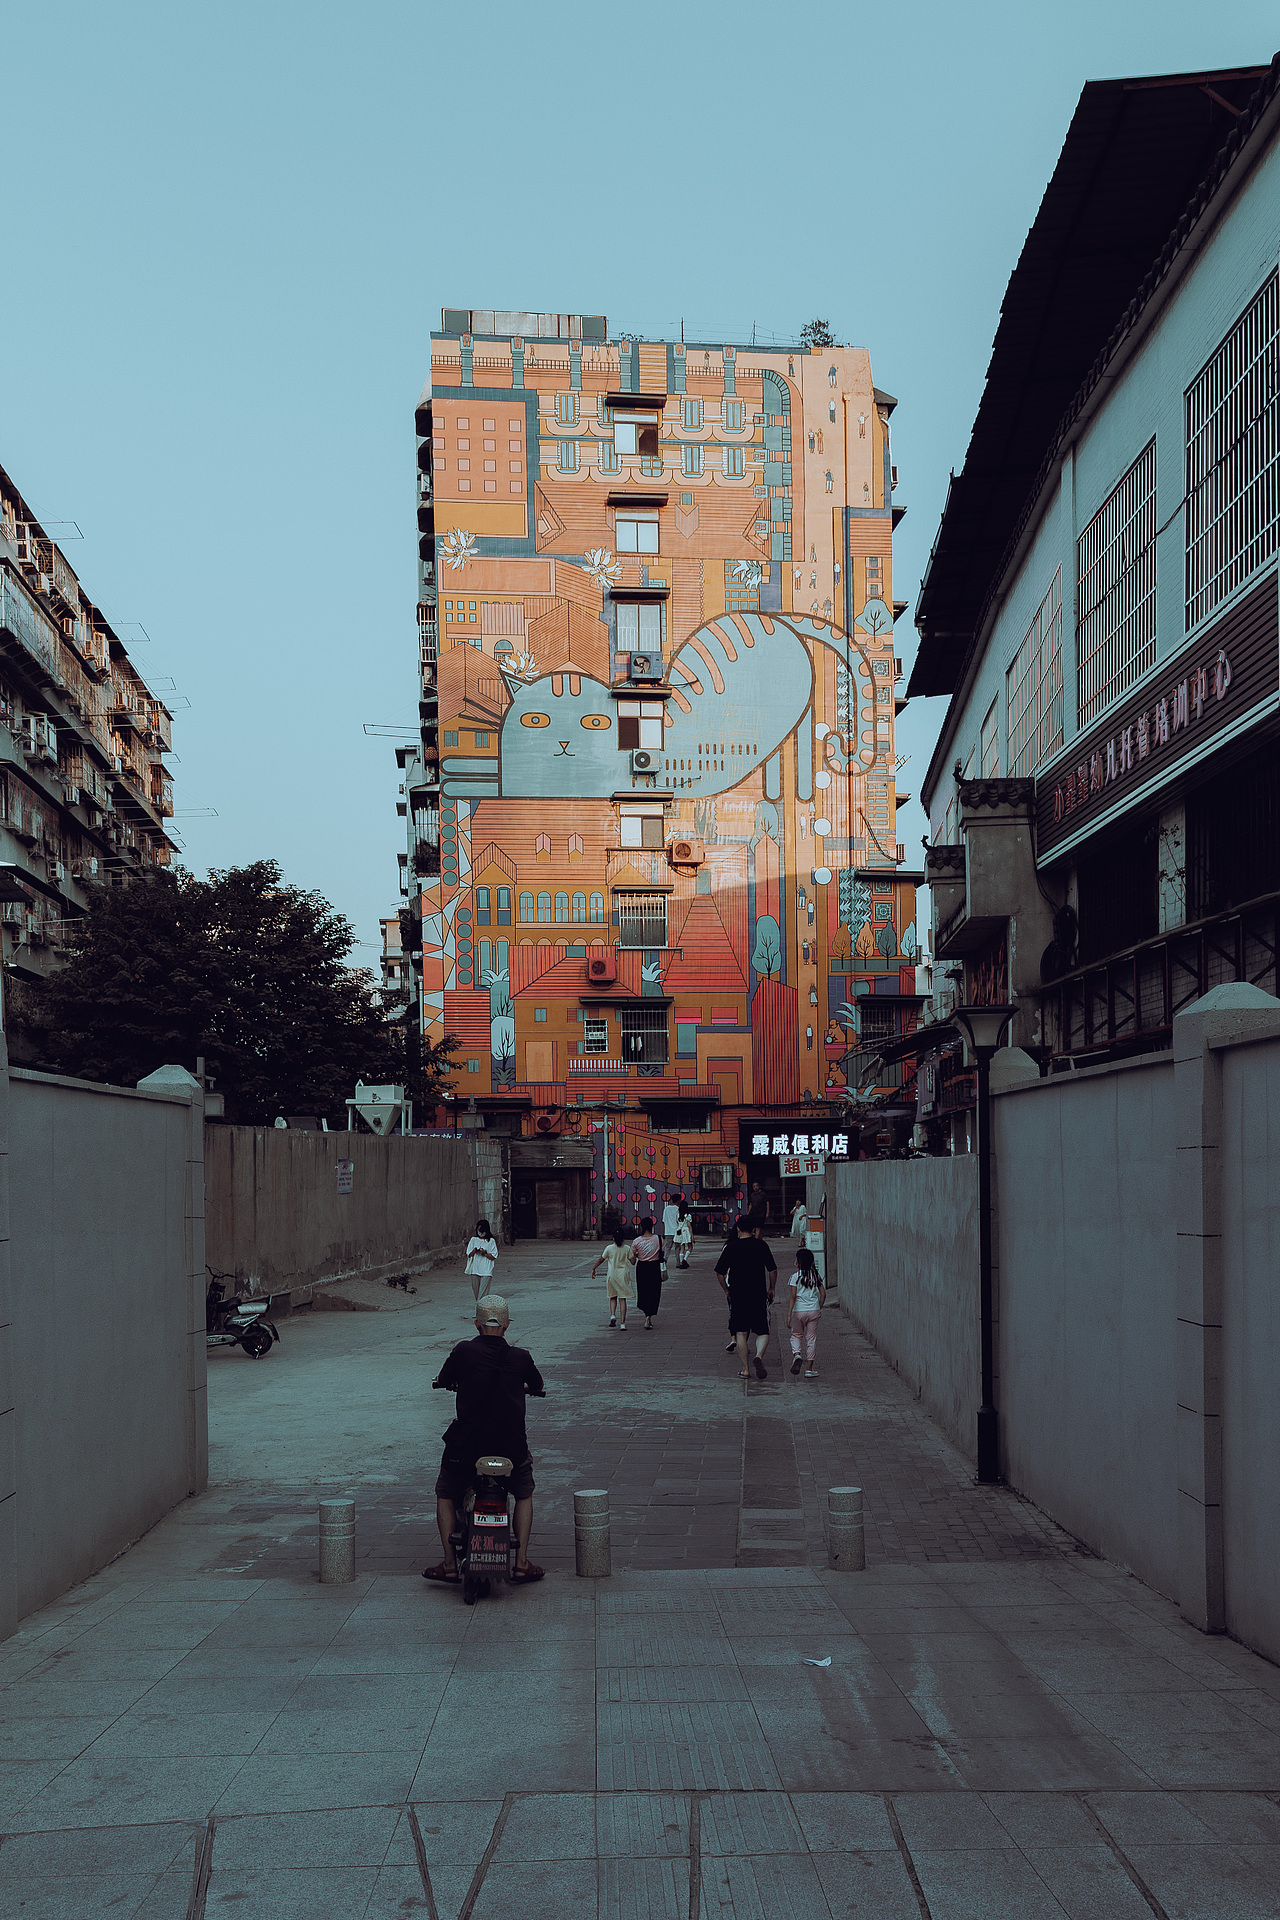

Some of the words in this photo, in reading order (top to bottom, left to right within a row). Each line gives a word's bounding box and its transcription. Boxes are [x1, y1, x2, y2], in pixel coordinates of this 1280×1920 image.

[1053, 649, 1233, 823] 小星星幼儿托管培训中心
[752, 1133, 849, 1155] 露威便利店
[784, 1157, 819, 1174] 超市
